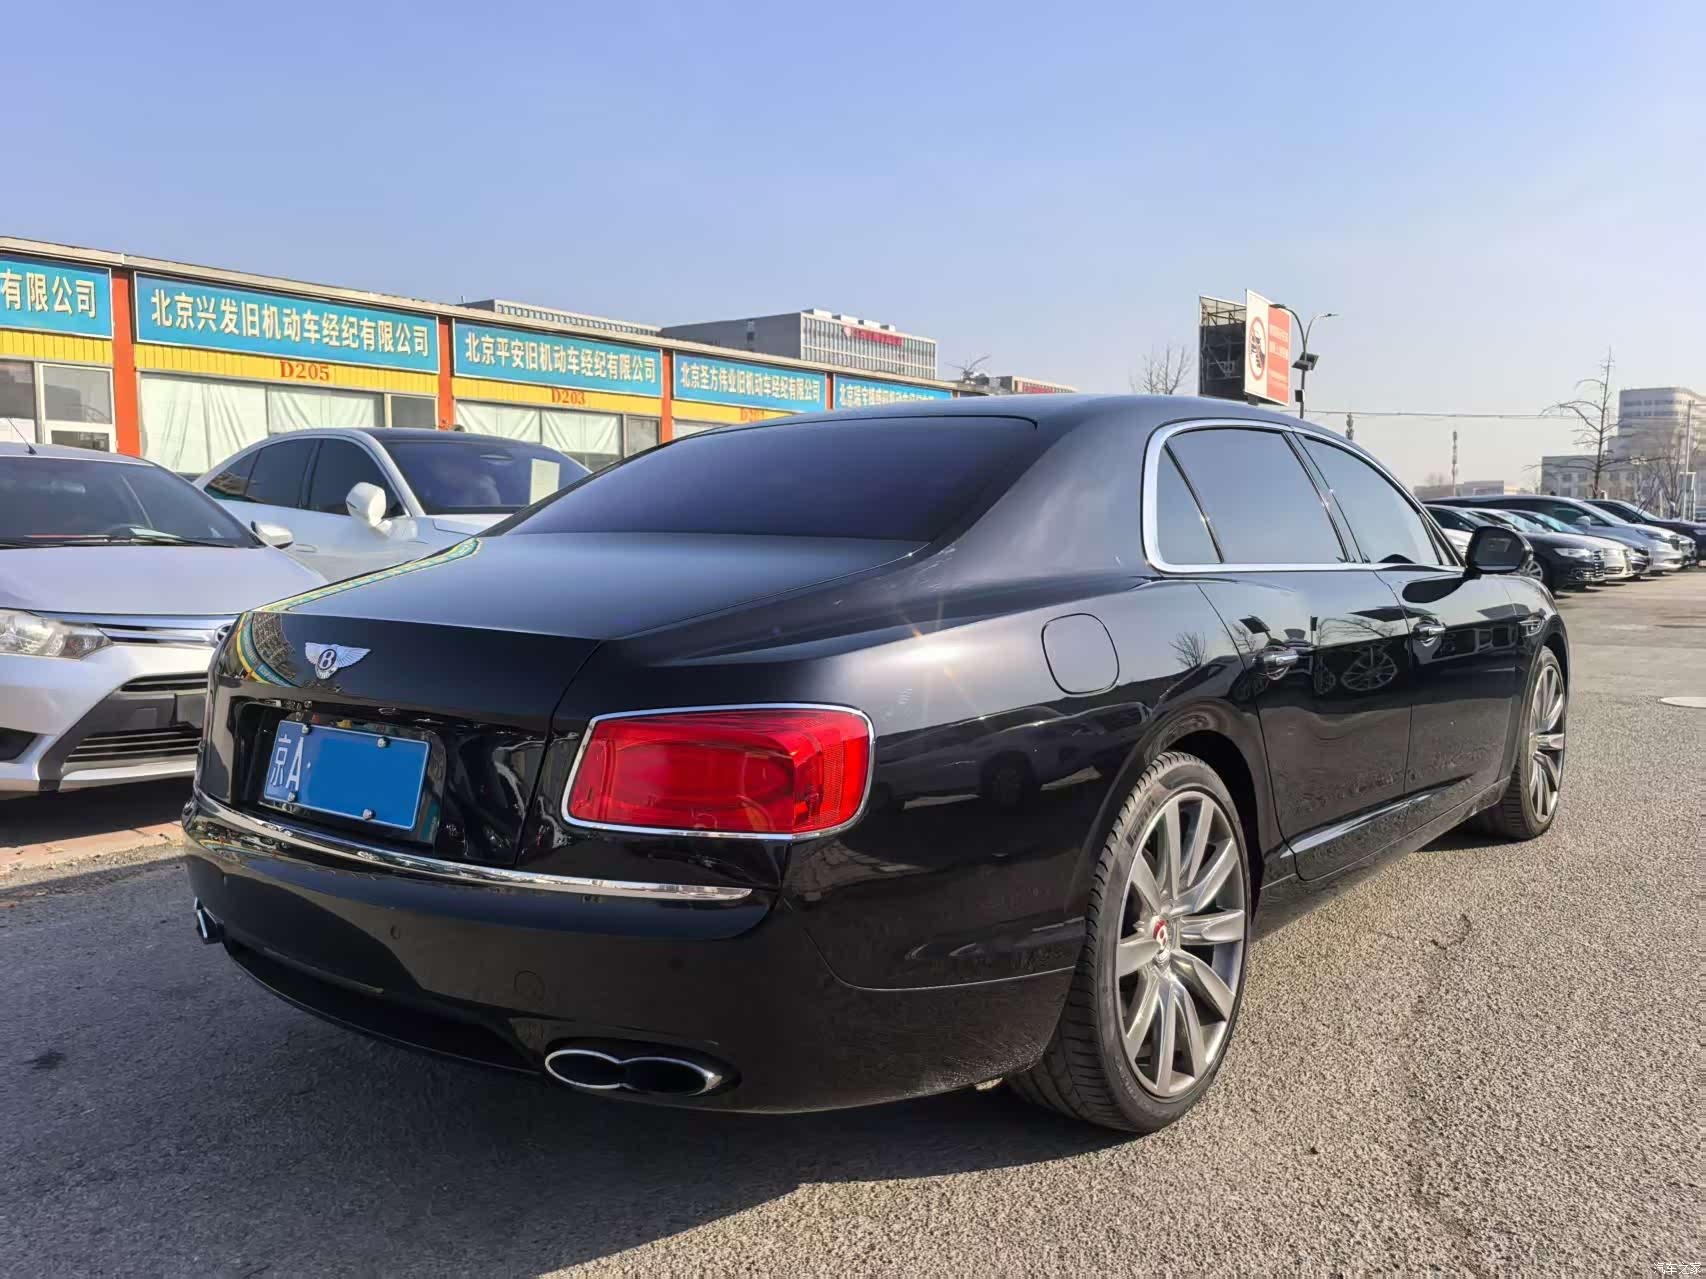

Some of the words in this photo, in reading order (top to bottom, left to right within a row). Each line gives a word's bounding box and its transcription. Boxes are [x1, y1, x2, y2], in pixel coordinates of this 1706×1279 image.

[0, 267, 97, 319] 有限公司
[150, 287, 430, 358] 北京兴发旧机动车经纪有限公司
[280, 359, 331, 381] D205
[464, 331, 656, 383] 北京平安旧机动车经纪有限公司
[551, 388, 586, 405] D203
